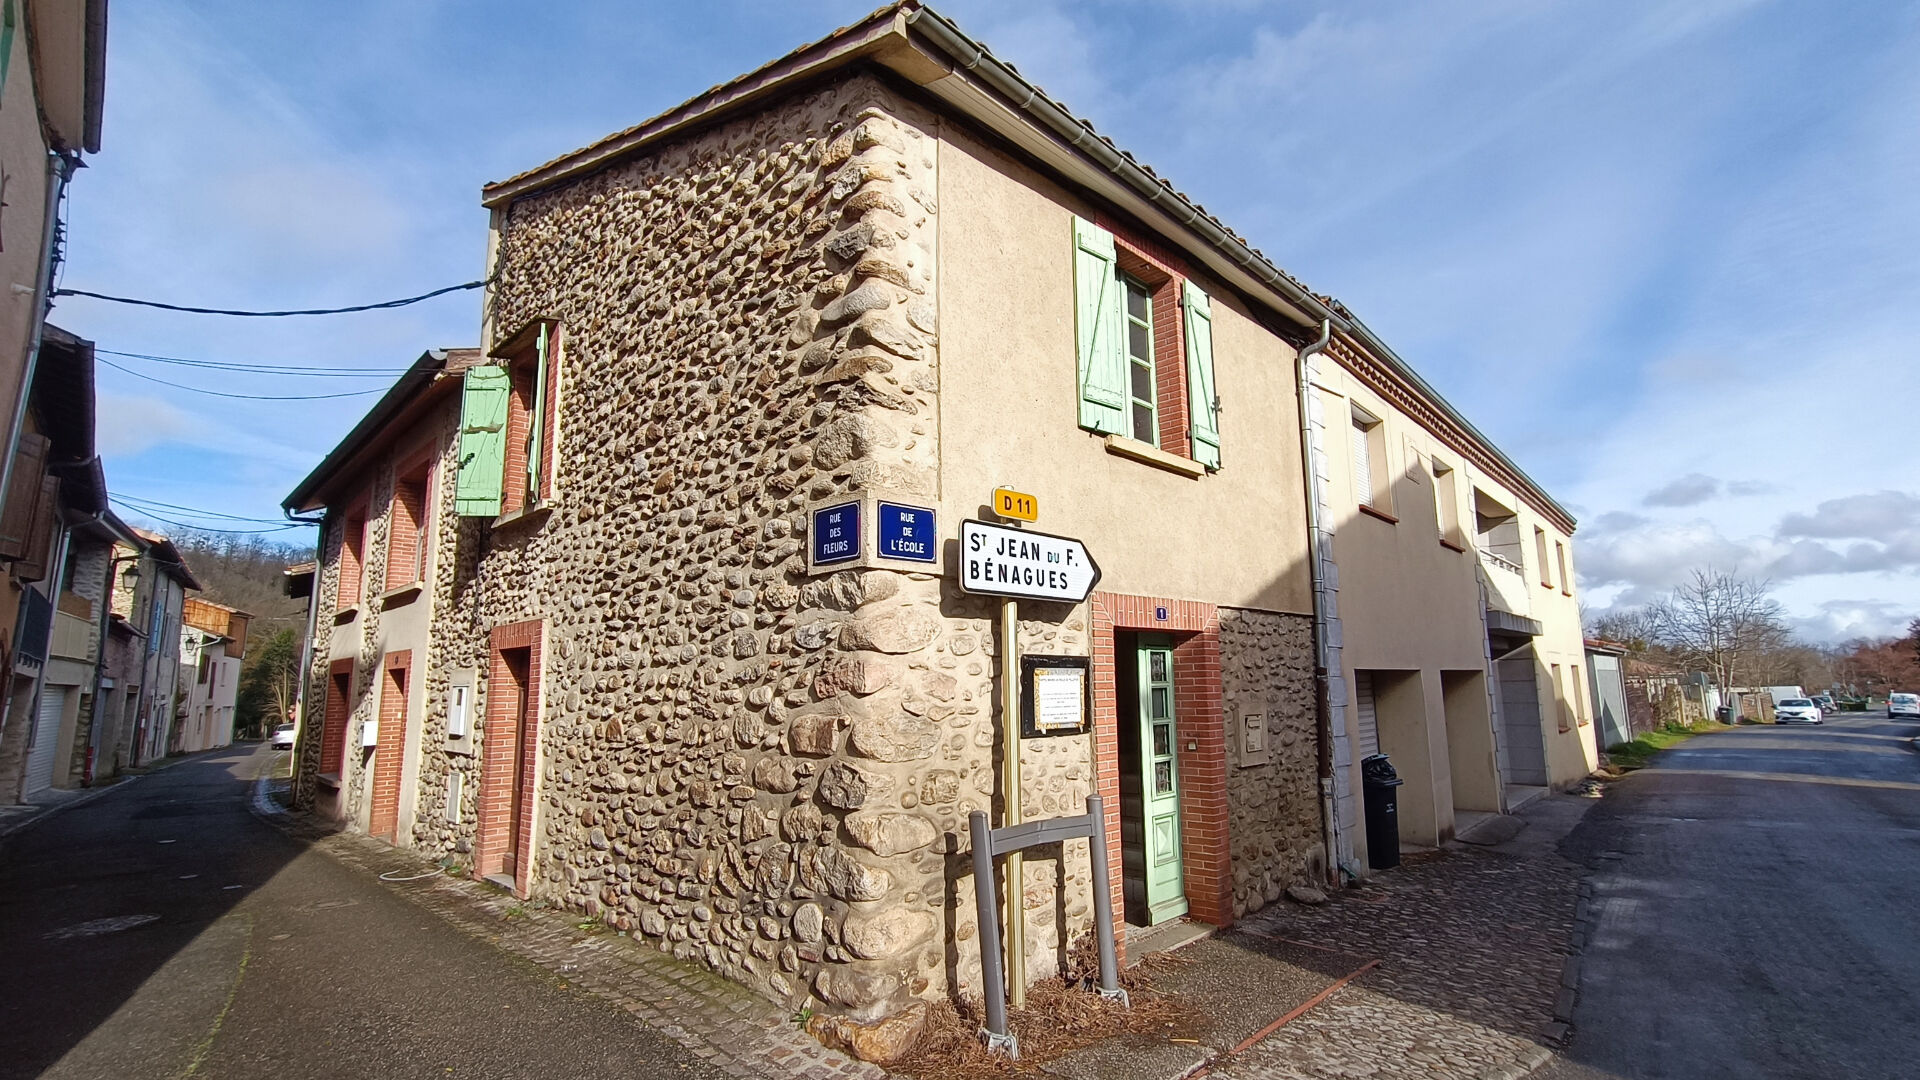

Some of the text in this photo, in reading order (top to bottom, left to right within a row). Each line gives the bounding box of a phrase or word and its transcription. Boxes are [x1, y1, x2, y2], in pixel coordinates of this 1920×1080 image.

[1004, 495, 1031, 515] D 11
[829, 512, 842, 524] RUE
[900, 512, 915, 524] RUE
[829, 527, 842, 538] DES
[902, 526, 913, 537] DE
[823, 540, 849, 555] FLEURS
[891, 538, 925, 554] L'ÉCOLE
[996, 537, 1041, 561] JEAN
[1047, 551, 1060, 564] DU
[1066, 548, 1079, 567] F.
[970, 557, 1068, 590] BÉNAGUES
